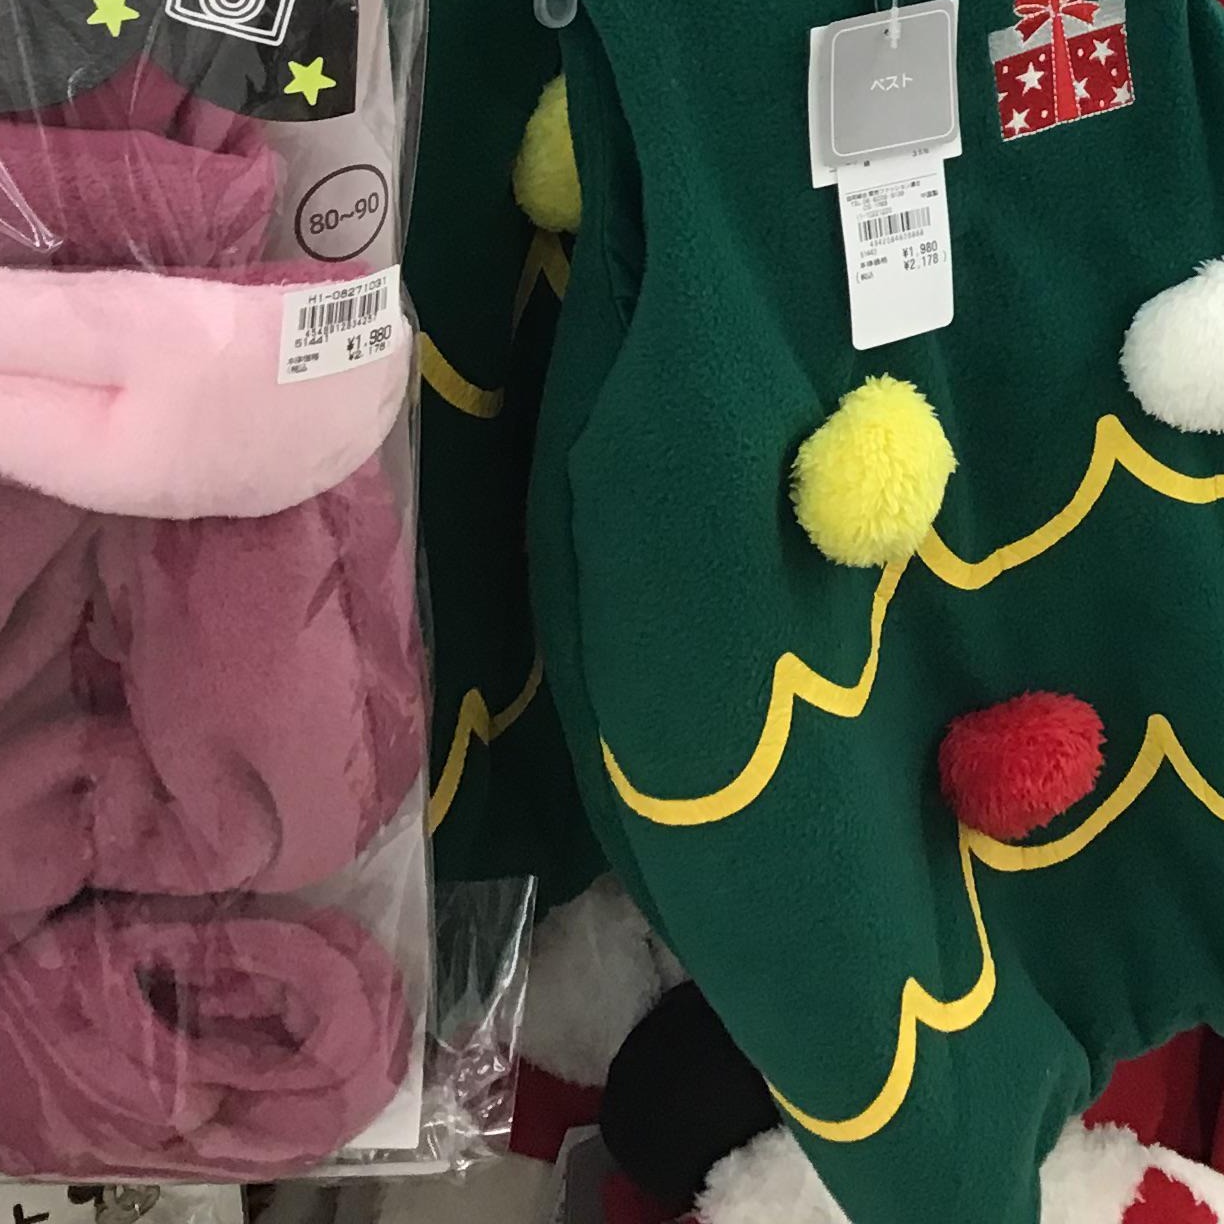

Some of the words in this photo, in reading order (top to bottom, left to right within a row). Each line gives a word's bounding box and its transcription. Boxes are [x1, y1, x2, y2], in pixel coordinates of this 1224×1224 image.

[870, 73, 914, 91] ベスト
[309, 192, 379, 235] 80~90
[295, 334, 329, 348] 51441
